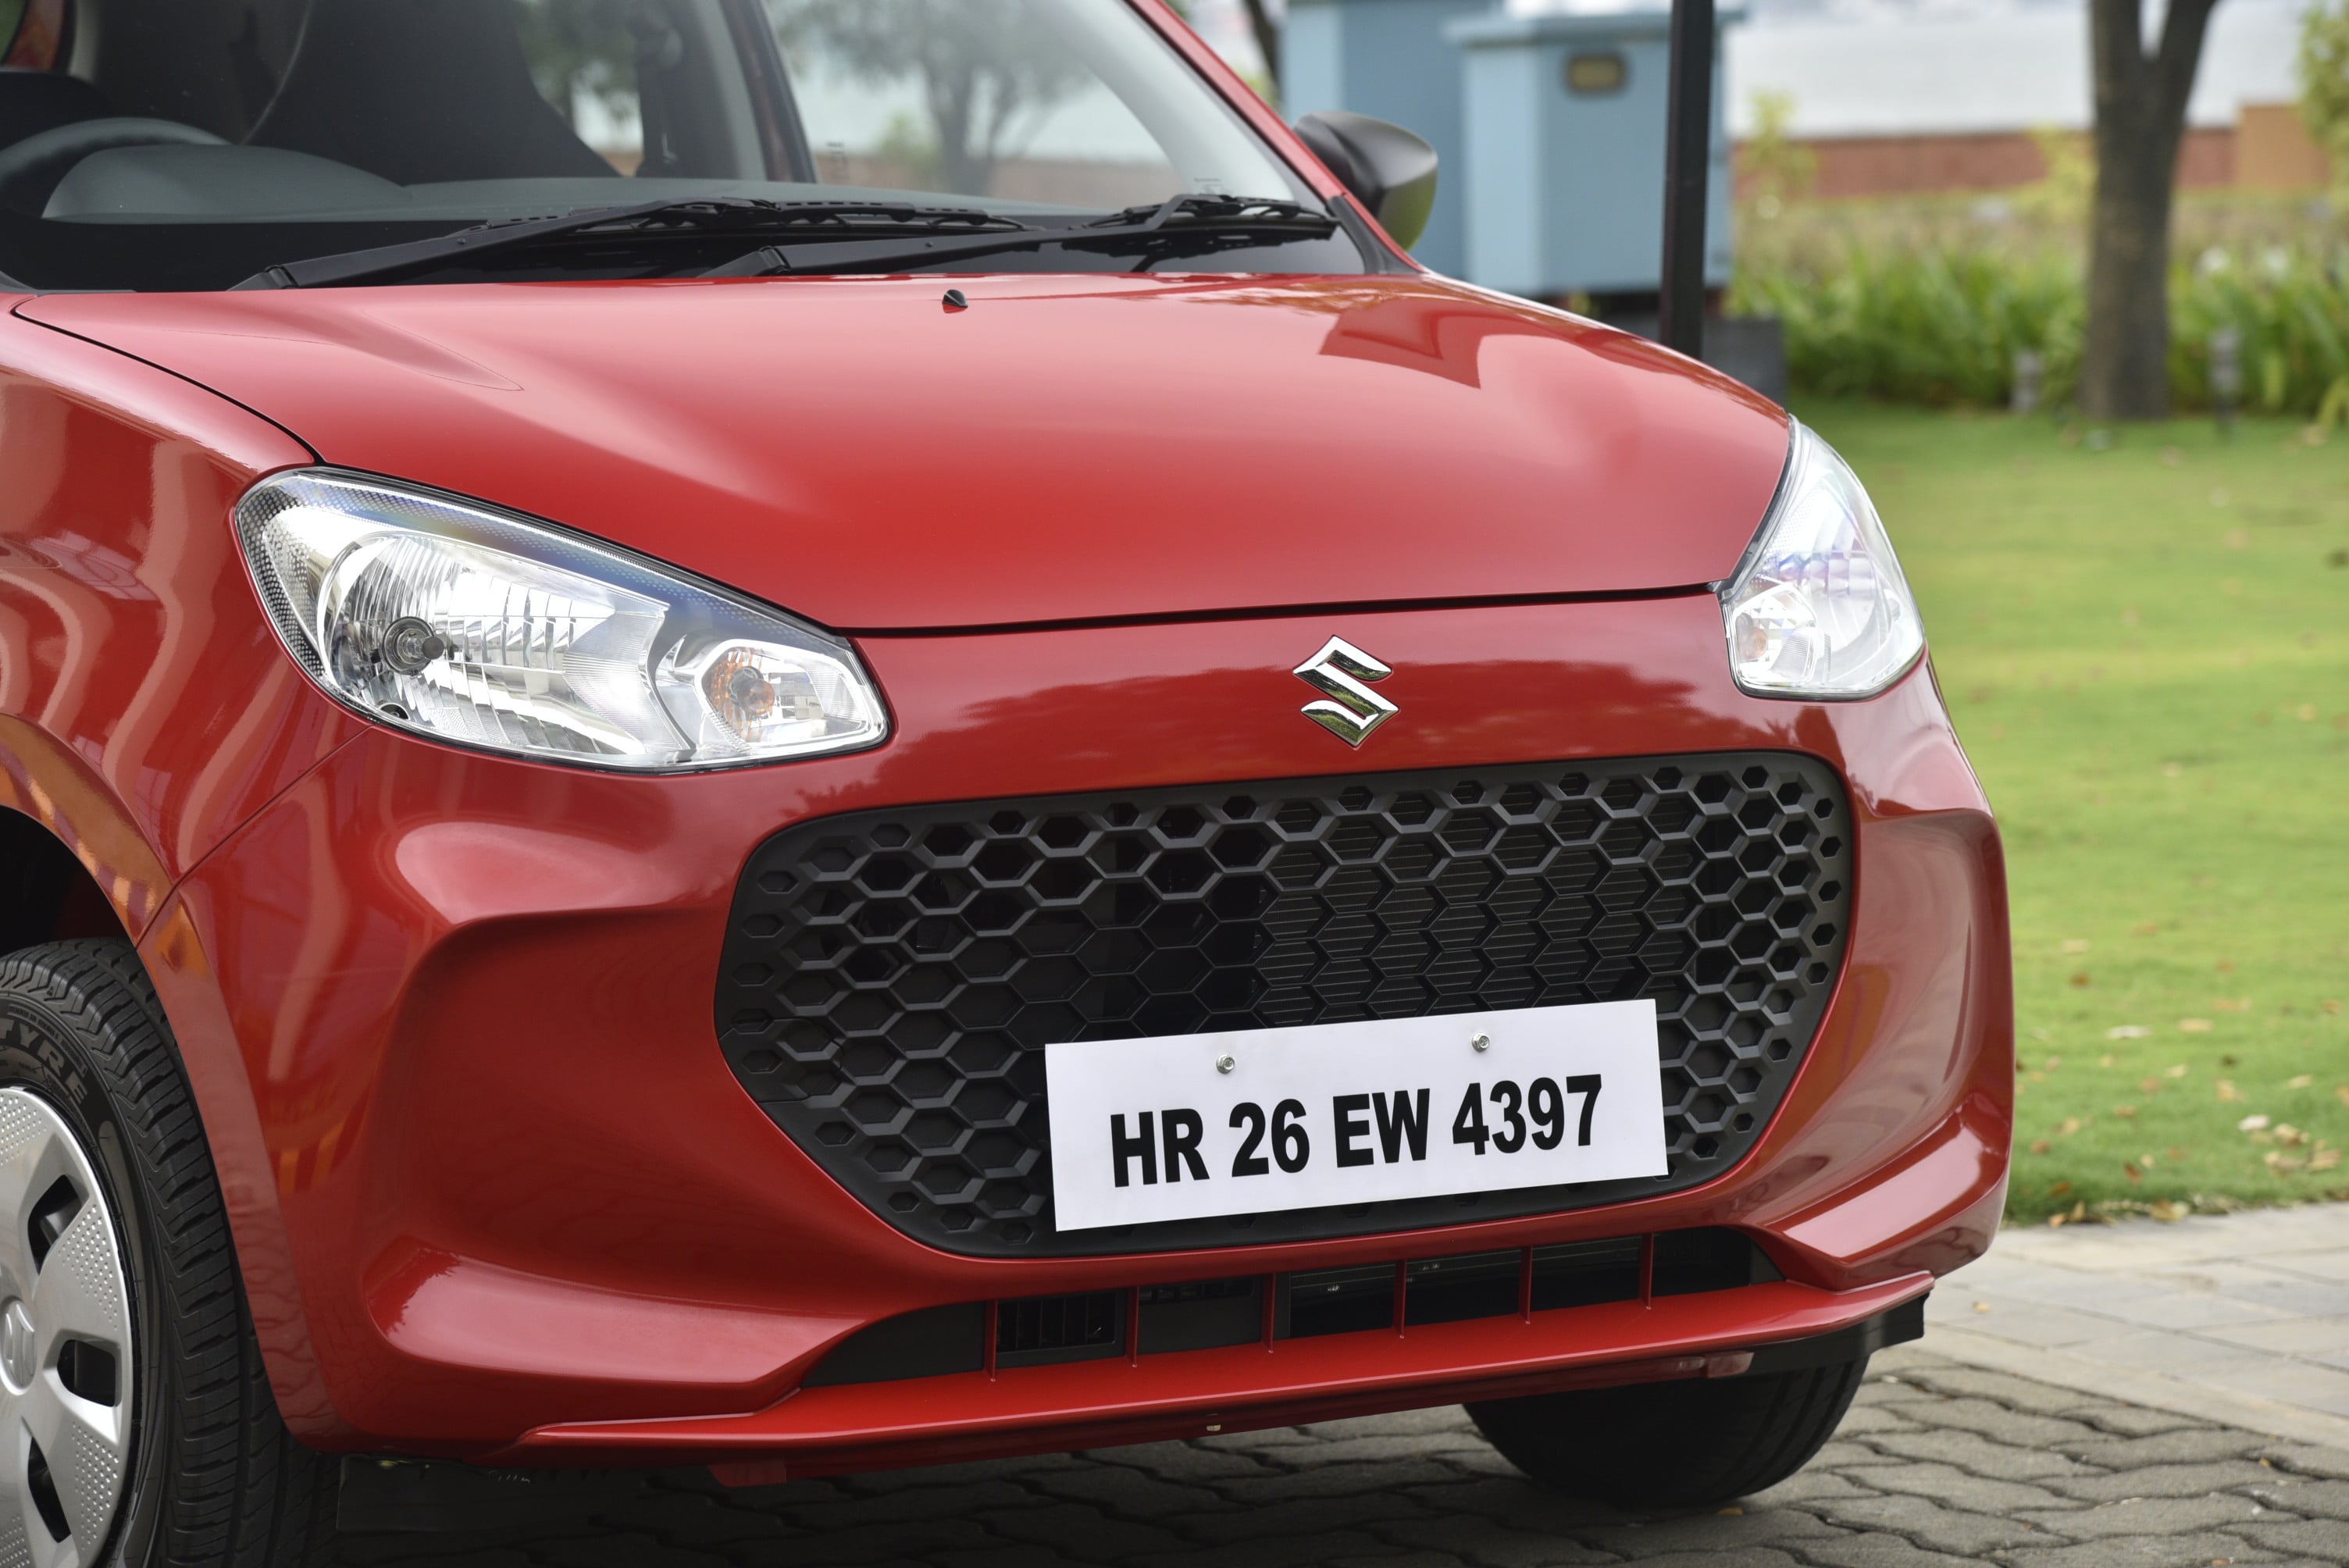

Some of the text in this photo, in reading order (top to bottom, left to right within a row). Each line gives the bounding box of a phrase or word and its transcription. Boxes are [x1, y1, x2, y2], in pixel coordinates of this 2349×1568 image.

[1110, 1074, 1602, 1188] HR 26 EW 4397
